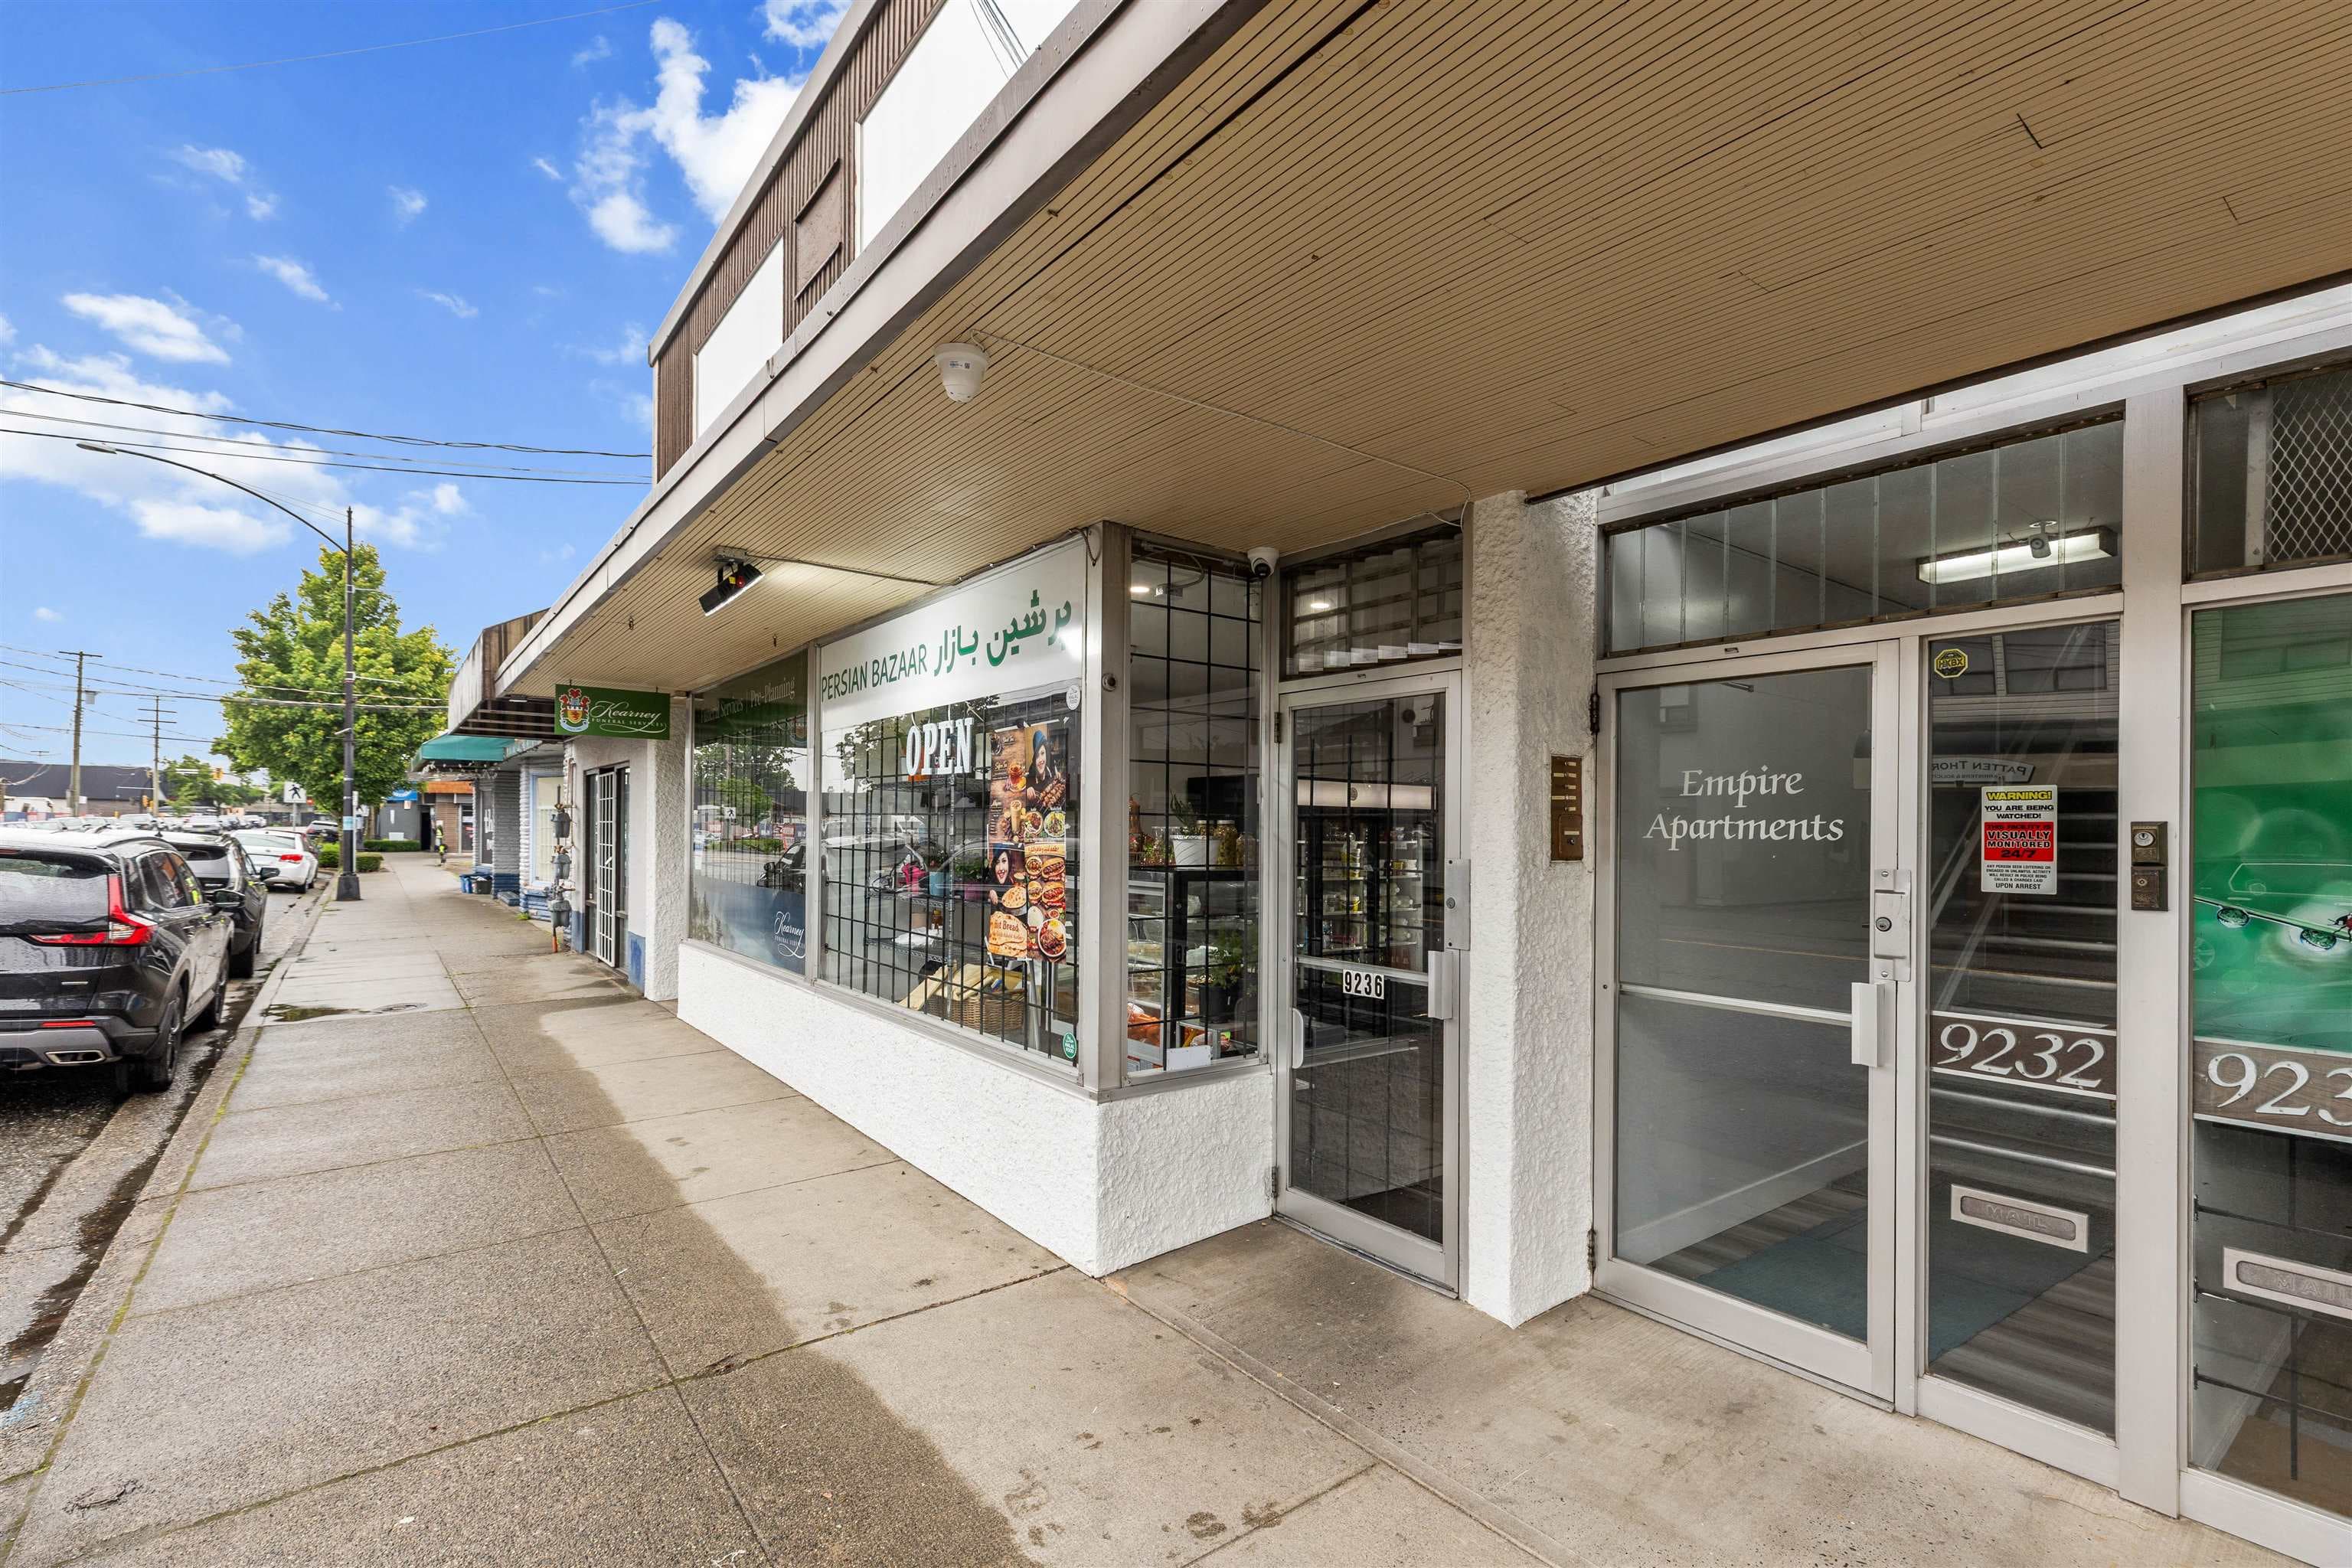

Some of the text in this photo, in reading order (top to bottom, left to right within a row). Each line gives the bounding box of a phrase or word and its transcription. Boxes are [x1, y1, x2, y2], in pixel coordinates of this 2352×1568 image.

[934, 625, 978, 676] بازار
[822, 644, 927, 702] PERSIAN BAZAAR
[590, 701, 663, 733] Kearney
[906, 717, 974, 776] OPEN
[1679, 765, 1805, 808] Empire
[1986, 791, 2053, 801] WARNING!
[1642, 815, 1844, 851] Apartments
[1987, 831, 2051, 840] VISUALLY
[2001, 849, 2037, 858] 24/7
[1003, 920, 1019, 932] Bread
[1345, 972, 1382, 997] 9236
[1937, 1024, 2105, 1088] 9232
[2208, 1053, 2352, 1126] 923
[1984, 1204, 2048, 1230] MAIL
